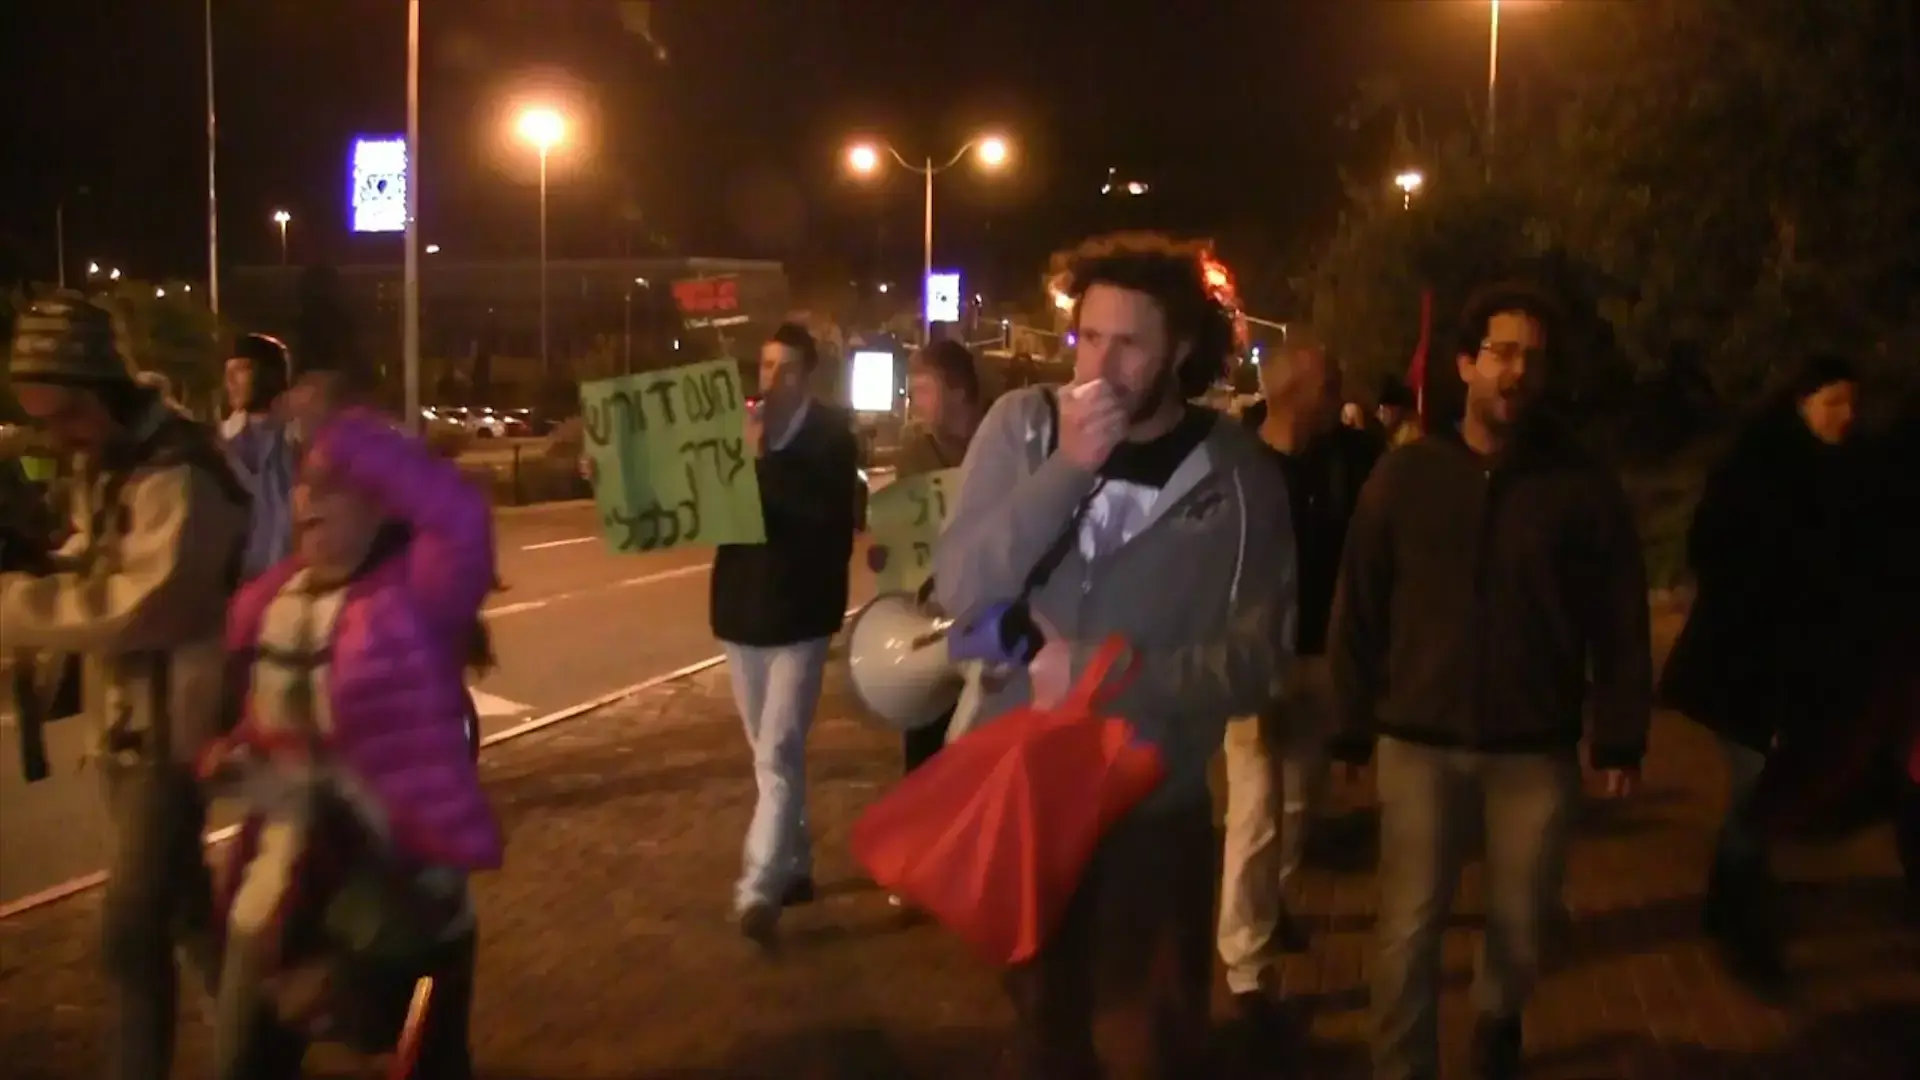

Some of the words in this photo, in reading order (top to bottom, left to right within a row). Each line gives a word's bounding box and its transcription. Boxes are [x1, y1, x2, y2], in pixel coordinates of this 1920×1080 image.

[584, 378, 677, 446] דורש
[683, 368, 737, 425] העם
[679, 437, 746, 500] צדק
